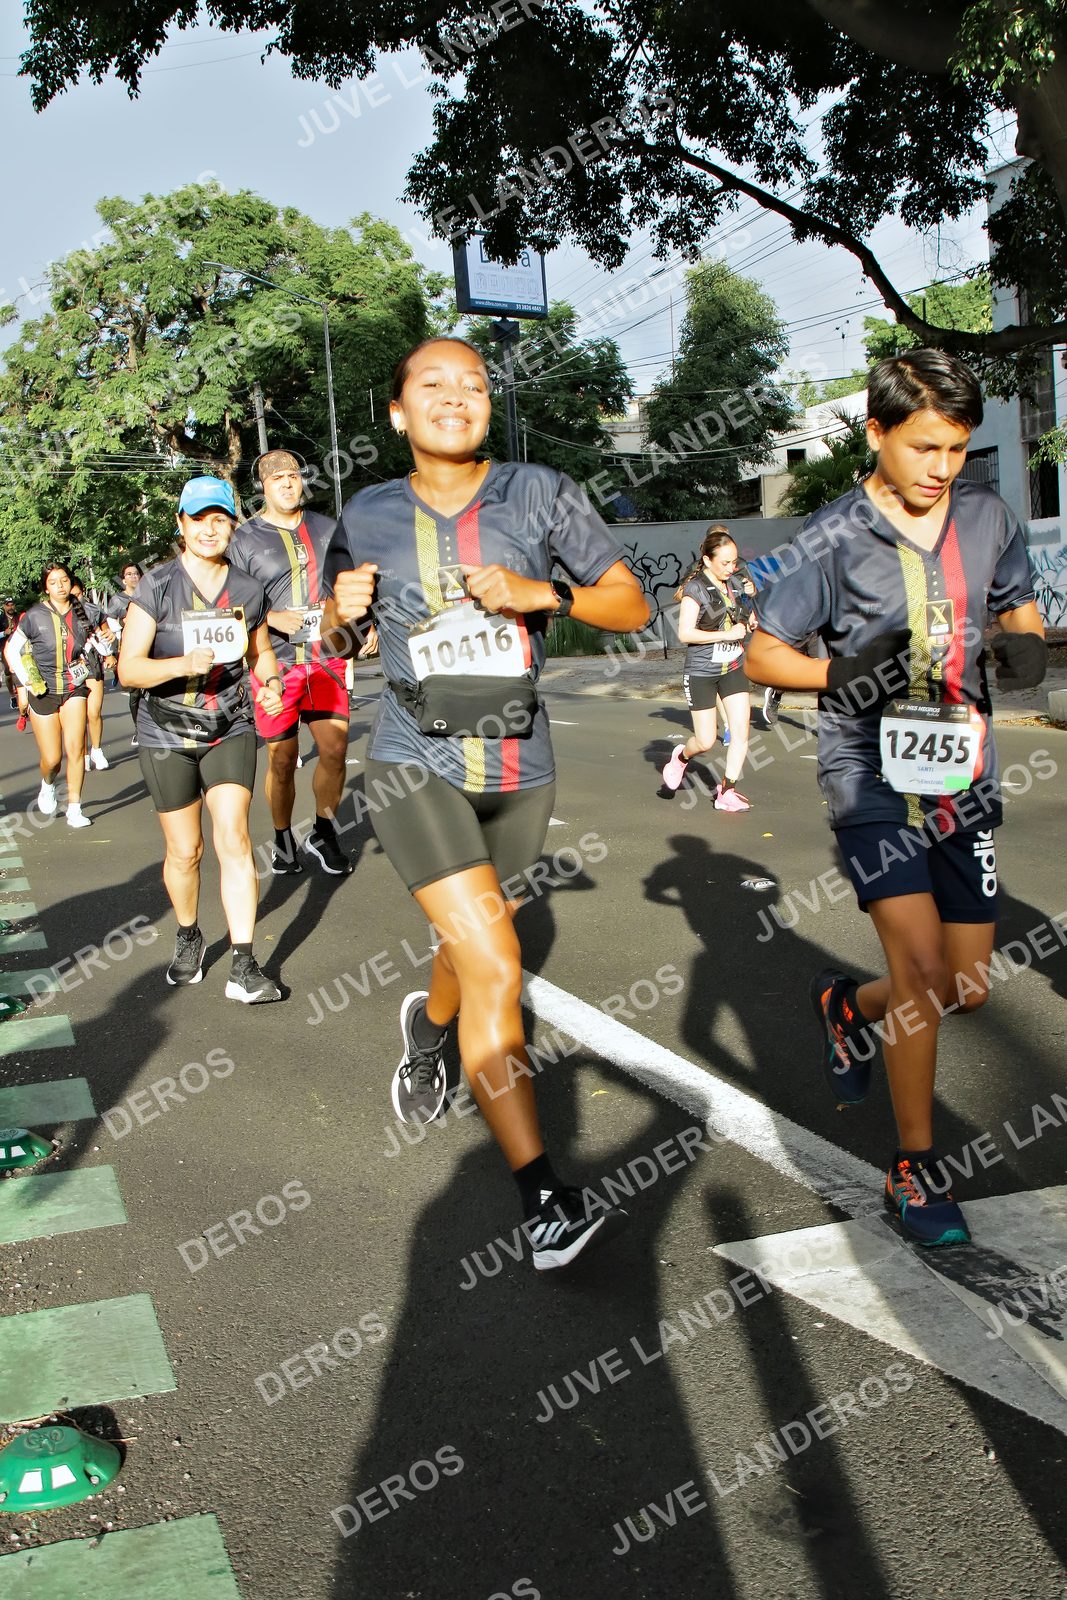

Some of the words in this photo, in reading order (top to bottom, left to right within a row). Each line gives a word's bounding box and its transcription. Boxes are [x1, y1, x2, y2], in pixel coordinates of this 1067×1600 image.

[192, 625, 235, 645] 1466
[417, 623, 513, 673] 10416
[886, 729, 971, 765] 12455
